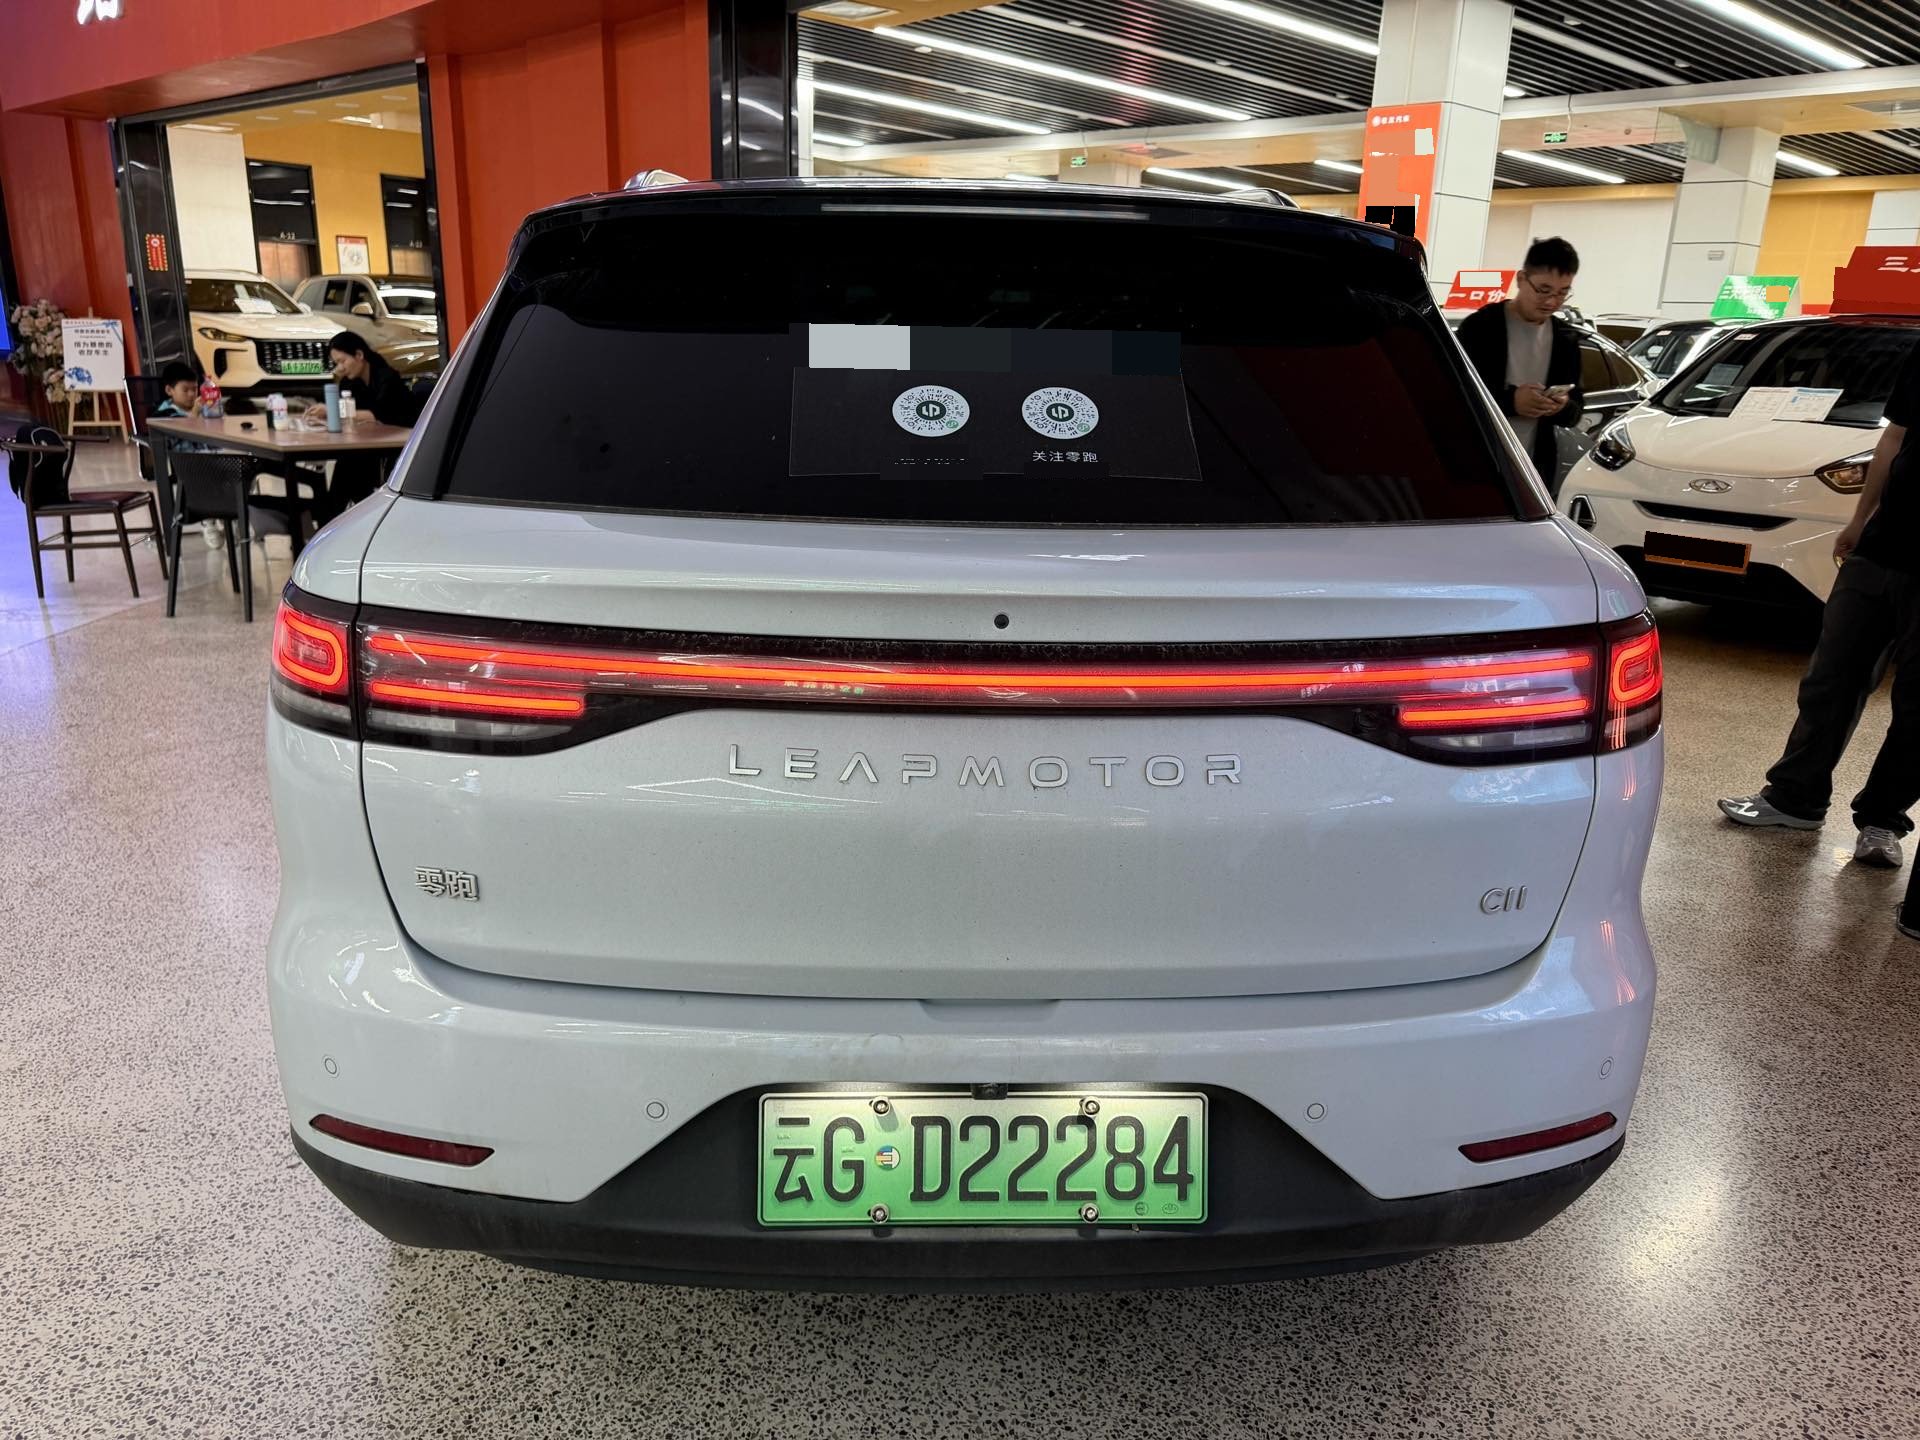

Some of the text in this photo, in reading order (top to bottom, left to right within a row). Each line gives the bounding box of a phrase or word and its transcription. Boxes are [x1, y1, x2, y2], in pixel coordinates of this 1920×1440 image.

[1448, 289, 1506, 304] 一口价
[1032, 450, 1099, 463] 关注零跑
[727, 743, 1242, 789] LEAPMOTOR
[414, 866, 480, 902] 零跑
